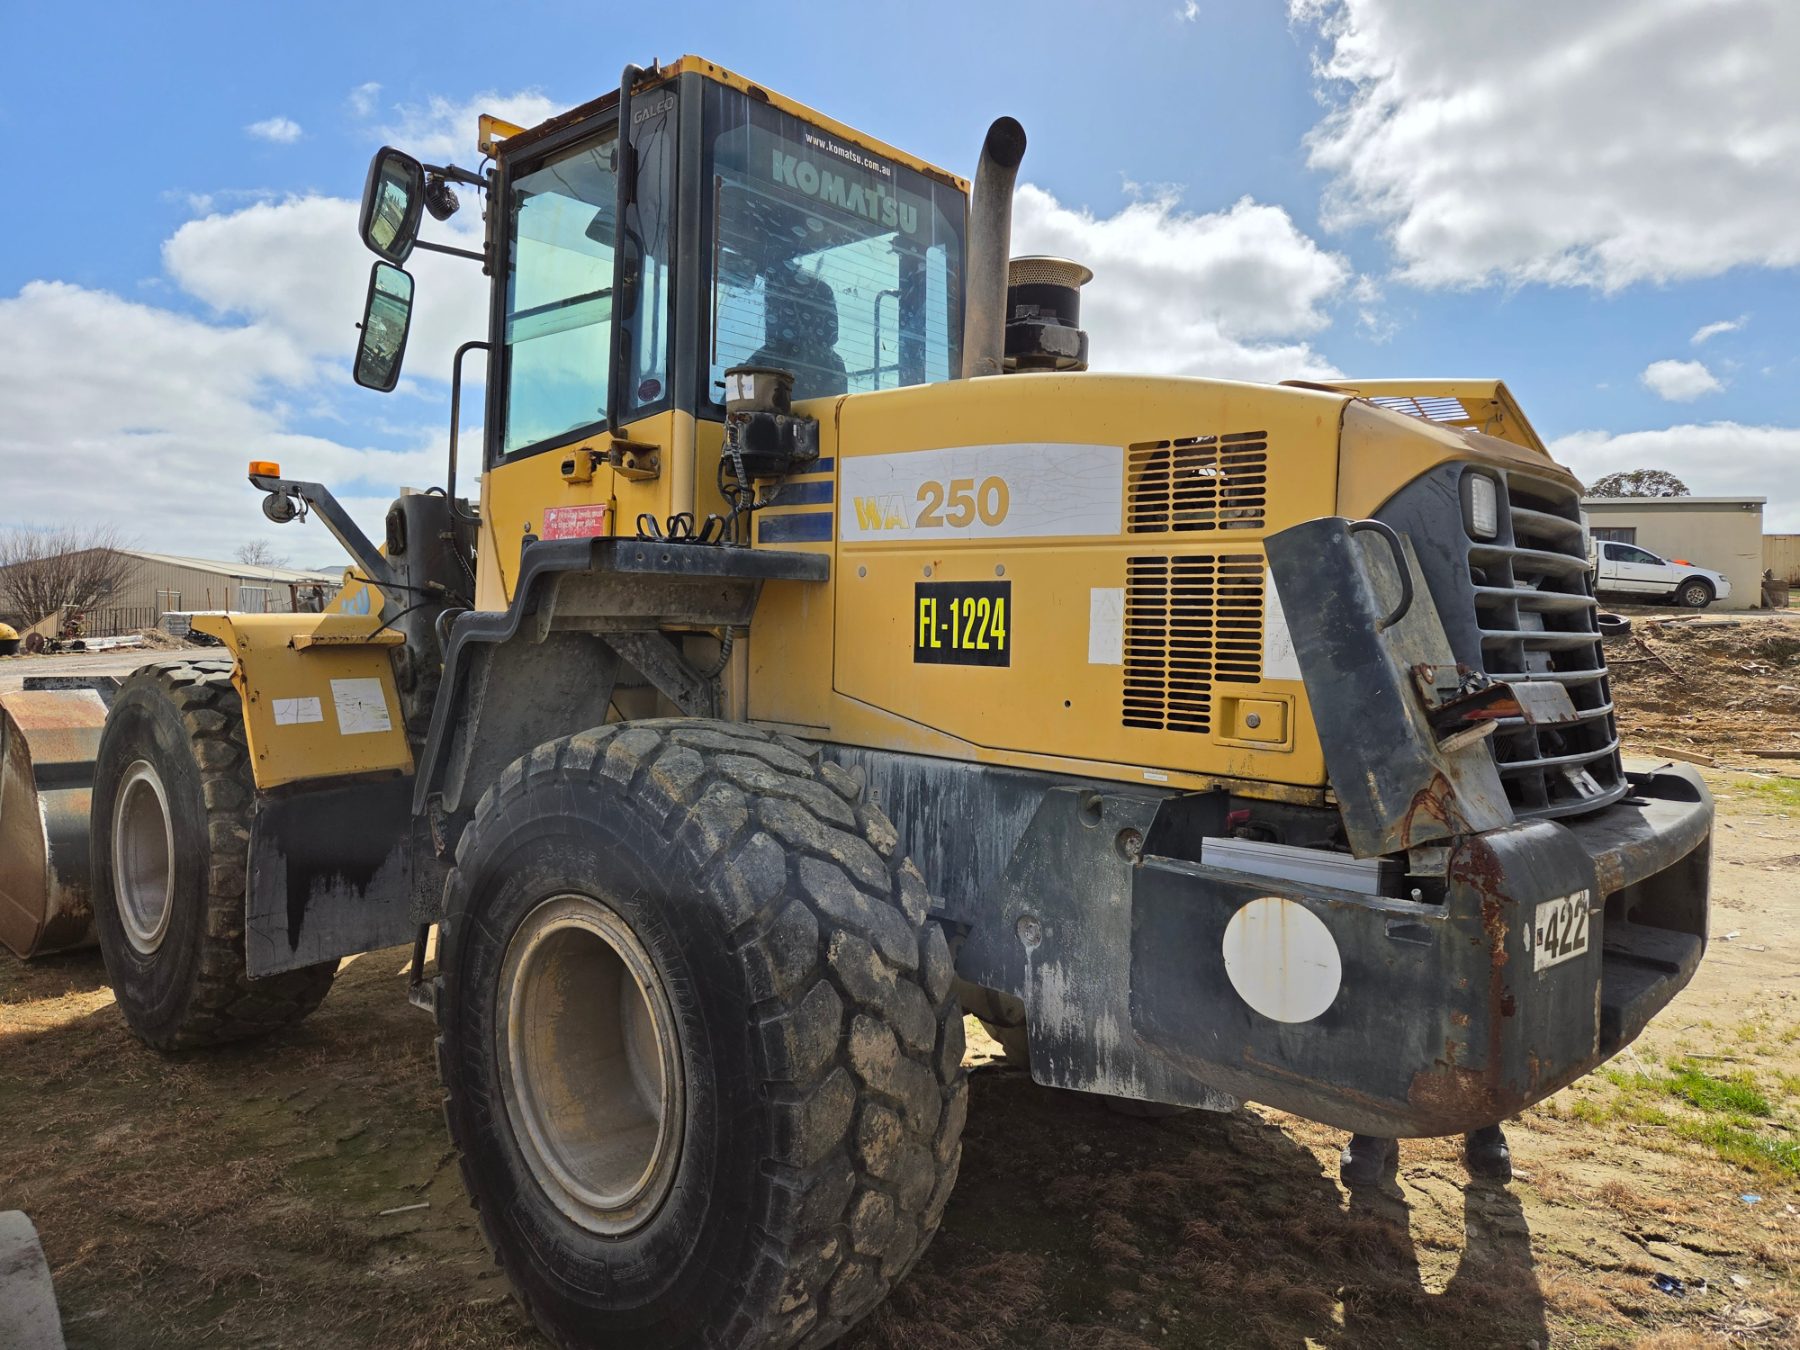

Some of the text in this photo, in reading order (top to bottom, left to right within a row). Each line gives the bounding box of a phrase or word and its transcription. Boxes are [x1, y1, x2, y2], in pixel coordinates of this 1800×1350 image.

[634, 96, 674, 124] GALEO
[805, 132, 891, 177] www.komatsu.com.au
[772, 149, 917, 235] KOMATSU
[853, 475, 1010, 531] WA 250
[919, 597, 1006, 650] FL-1224
[1544, 897, 1587, 959] 422
